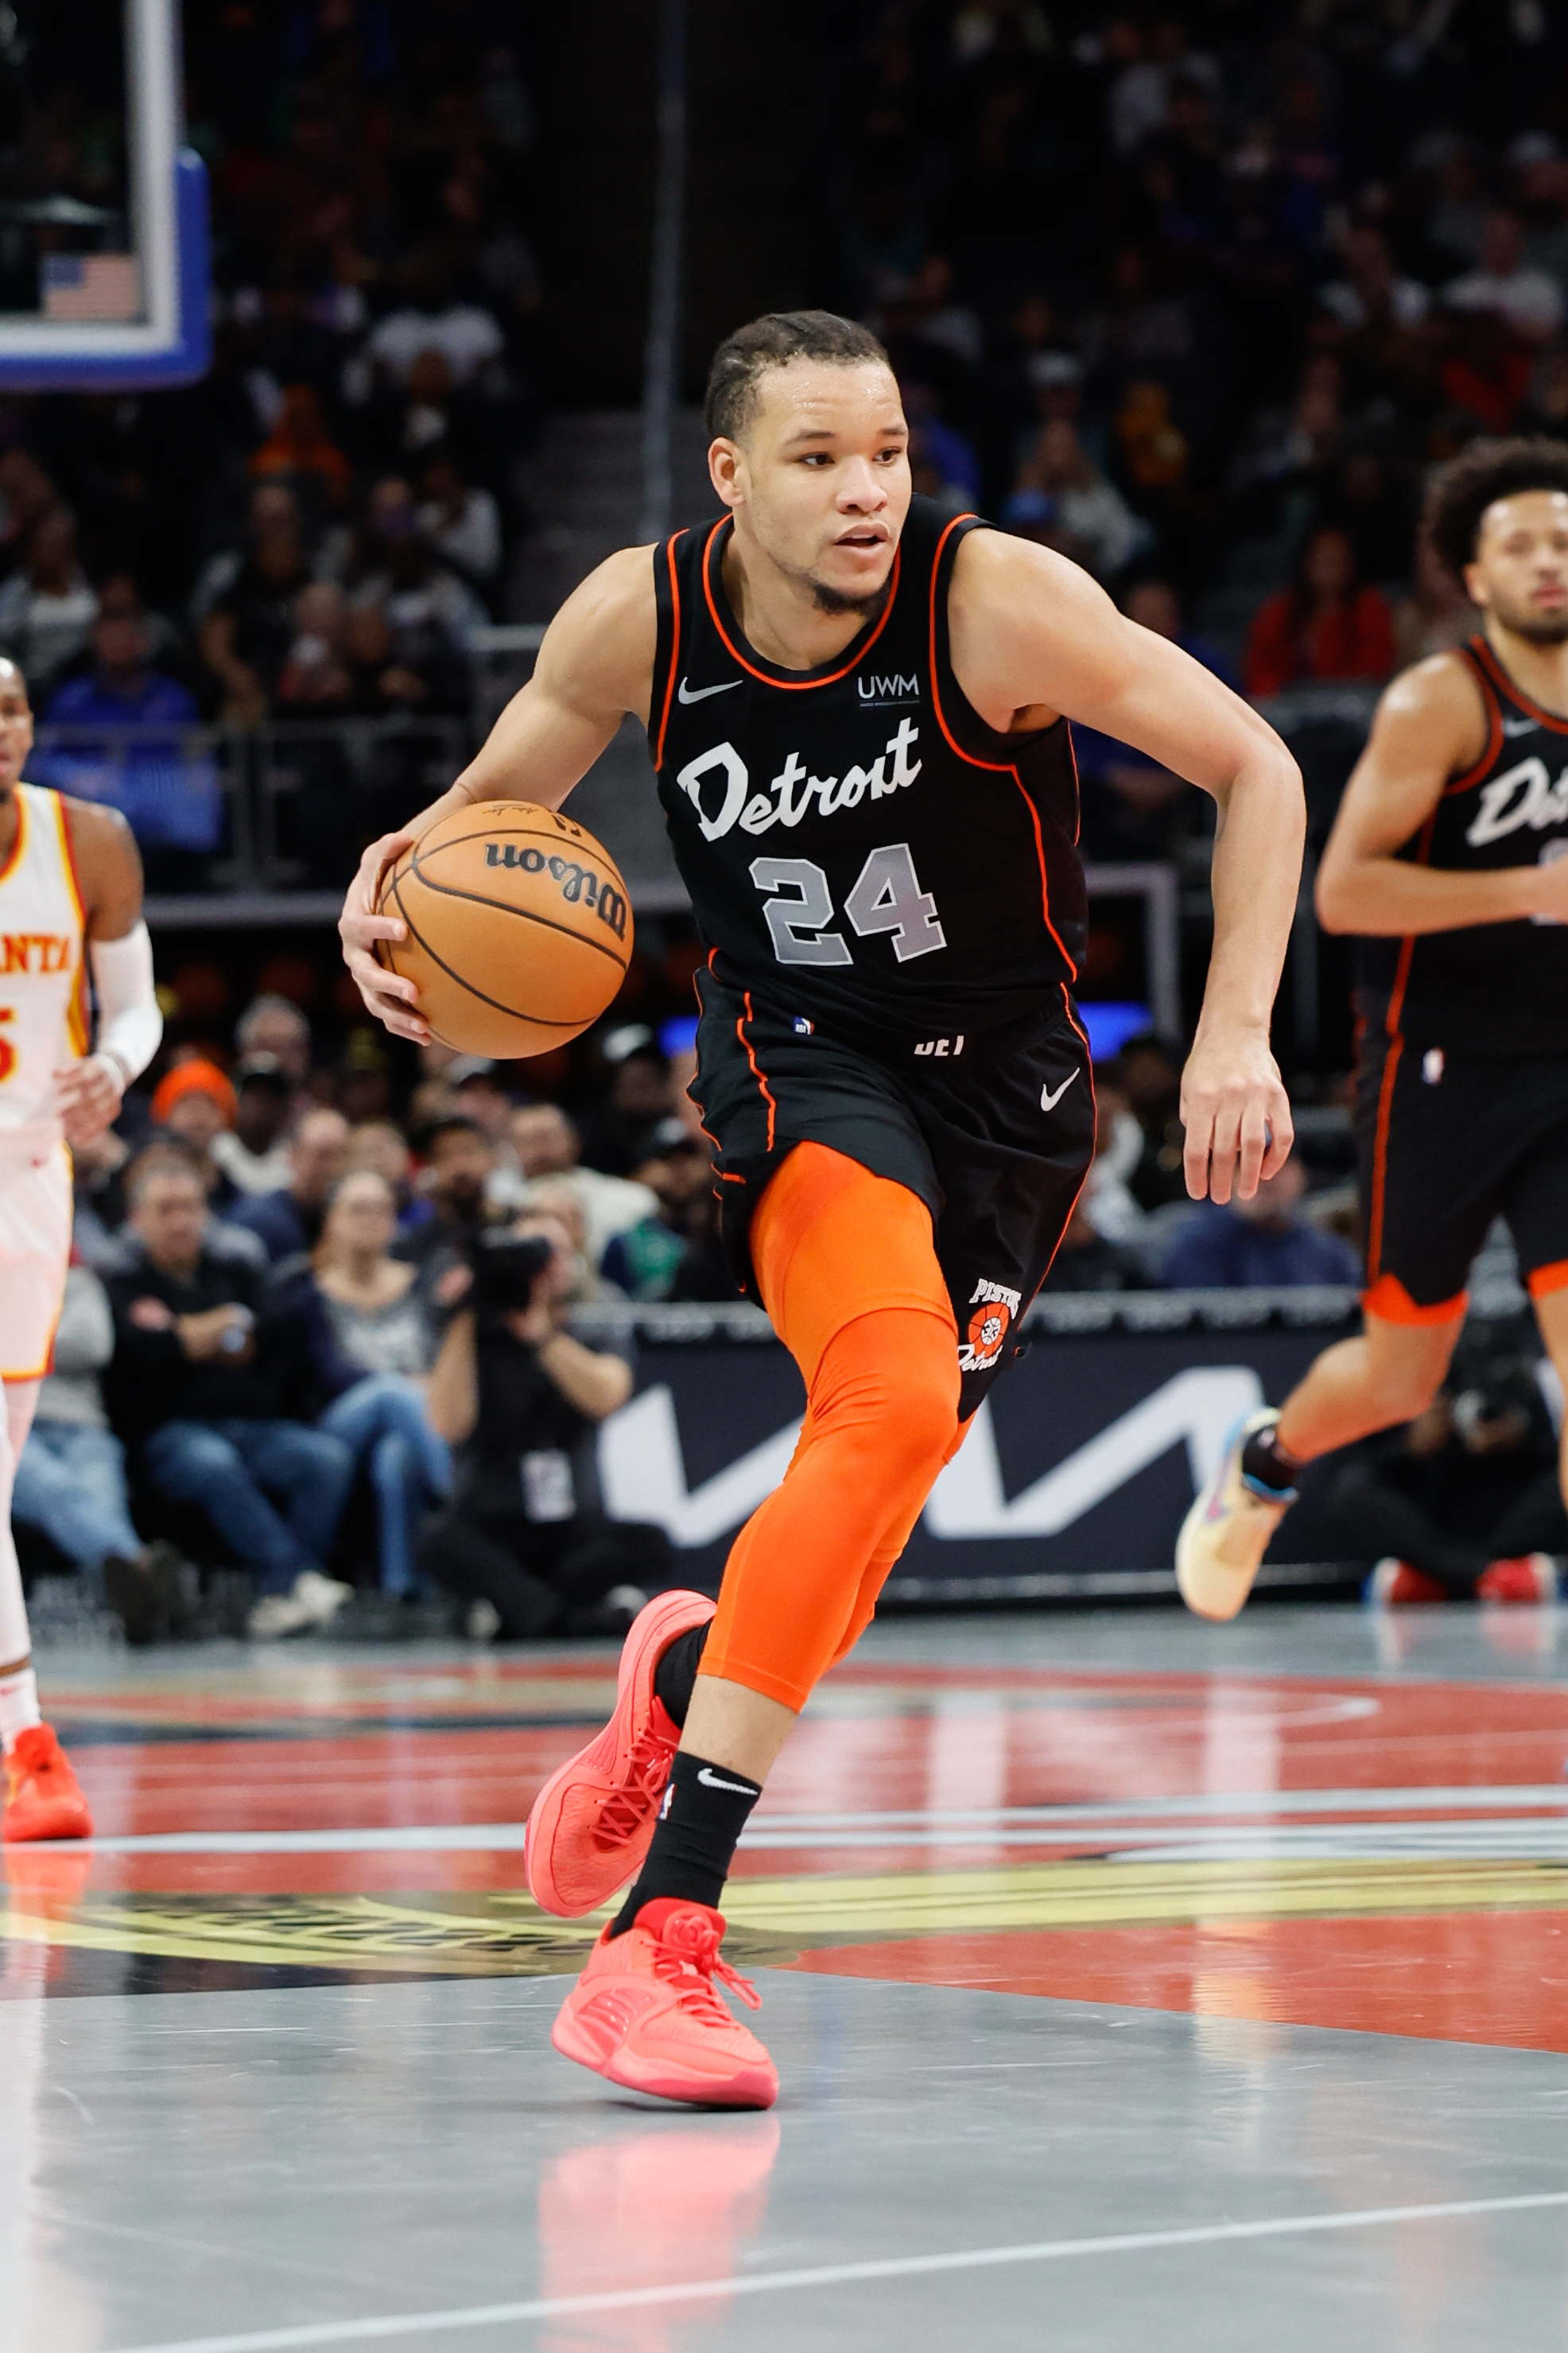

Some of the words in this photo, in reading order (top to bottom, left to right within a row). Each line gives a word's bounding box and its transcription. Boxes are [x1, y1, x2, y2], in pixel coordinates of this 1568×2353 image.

[858, 674, 920, 699] UWM
[677, 717, 922, 841] Detroit
[486, 844, 626, 942] Wilson
[748, 843, 947, 965] 24
